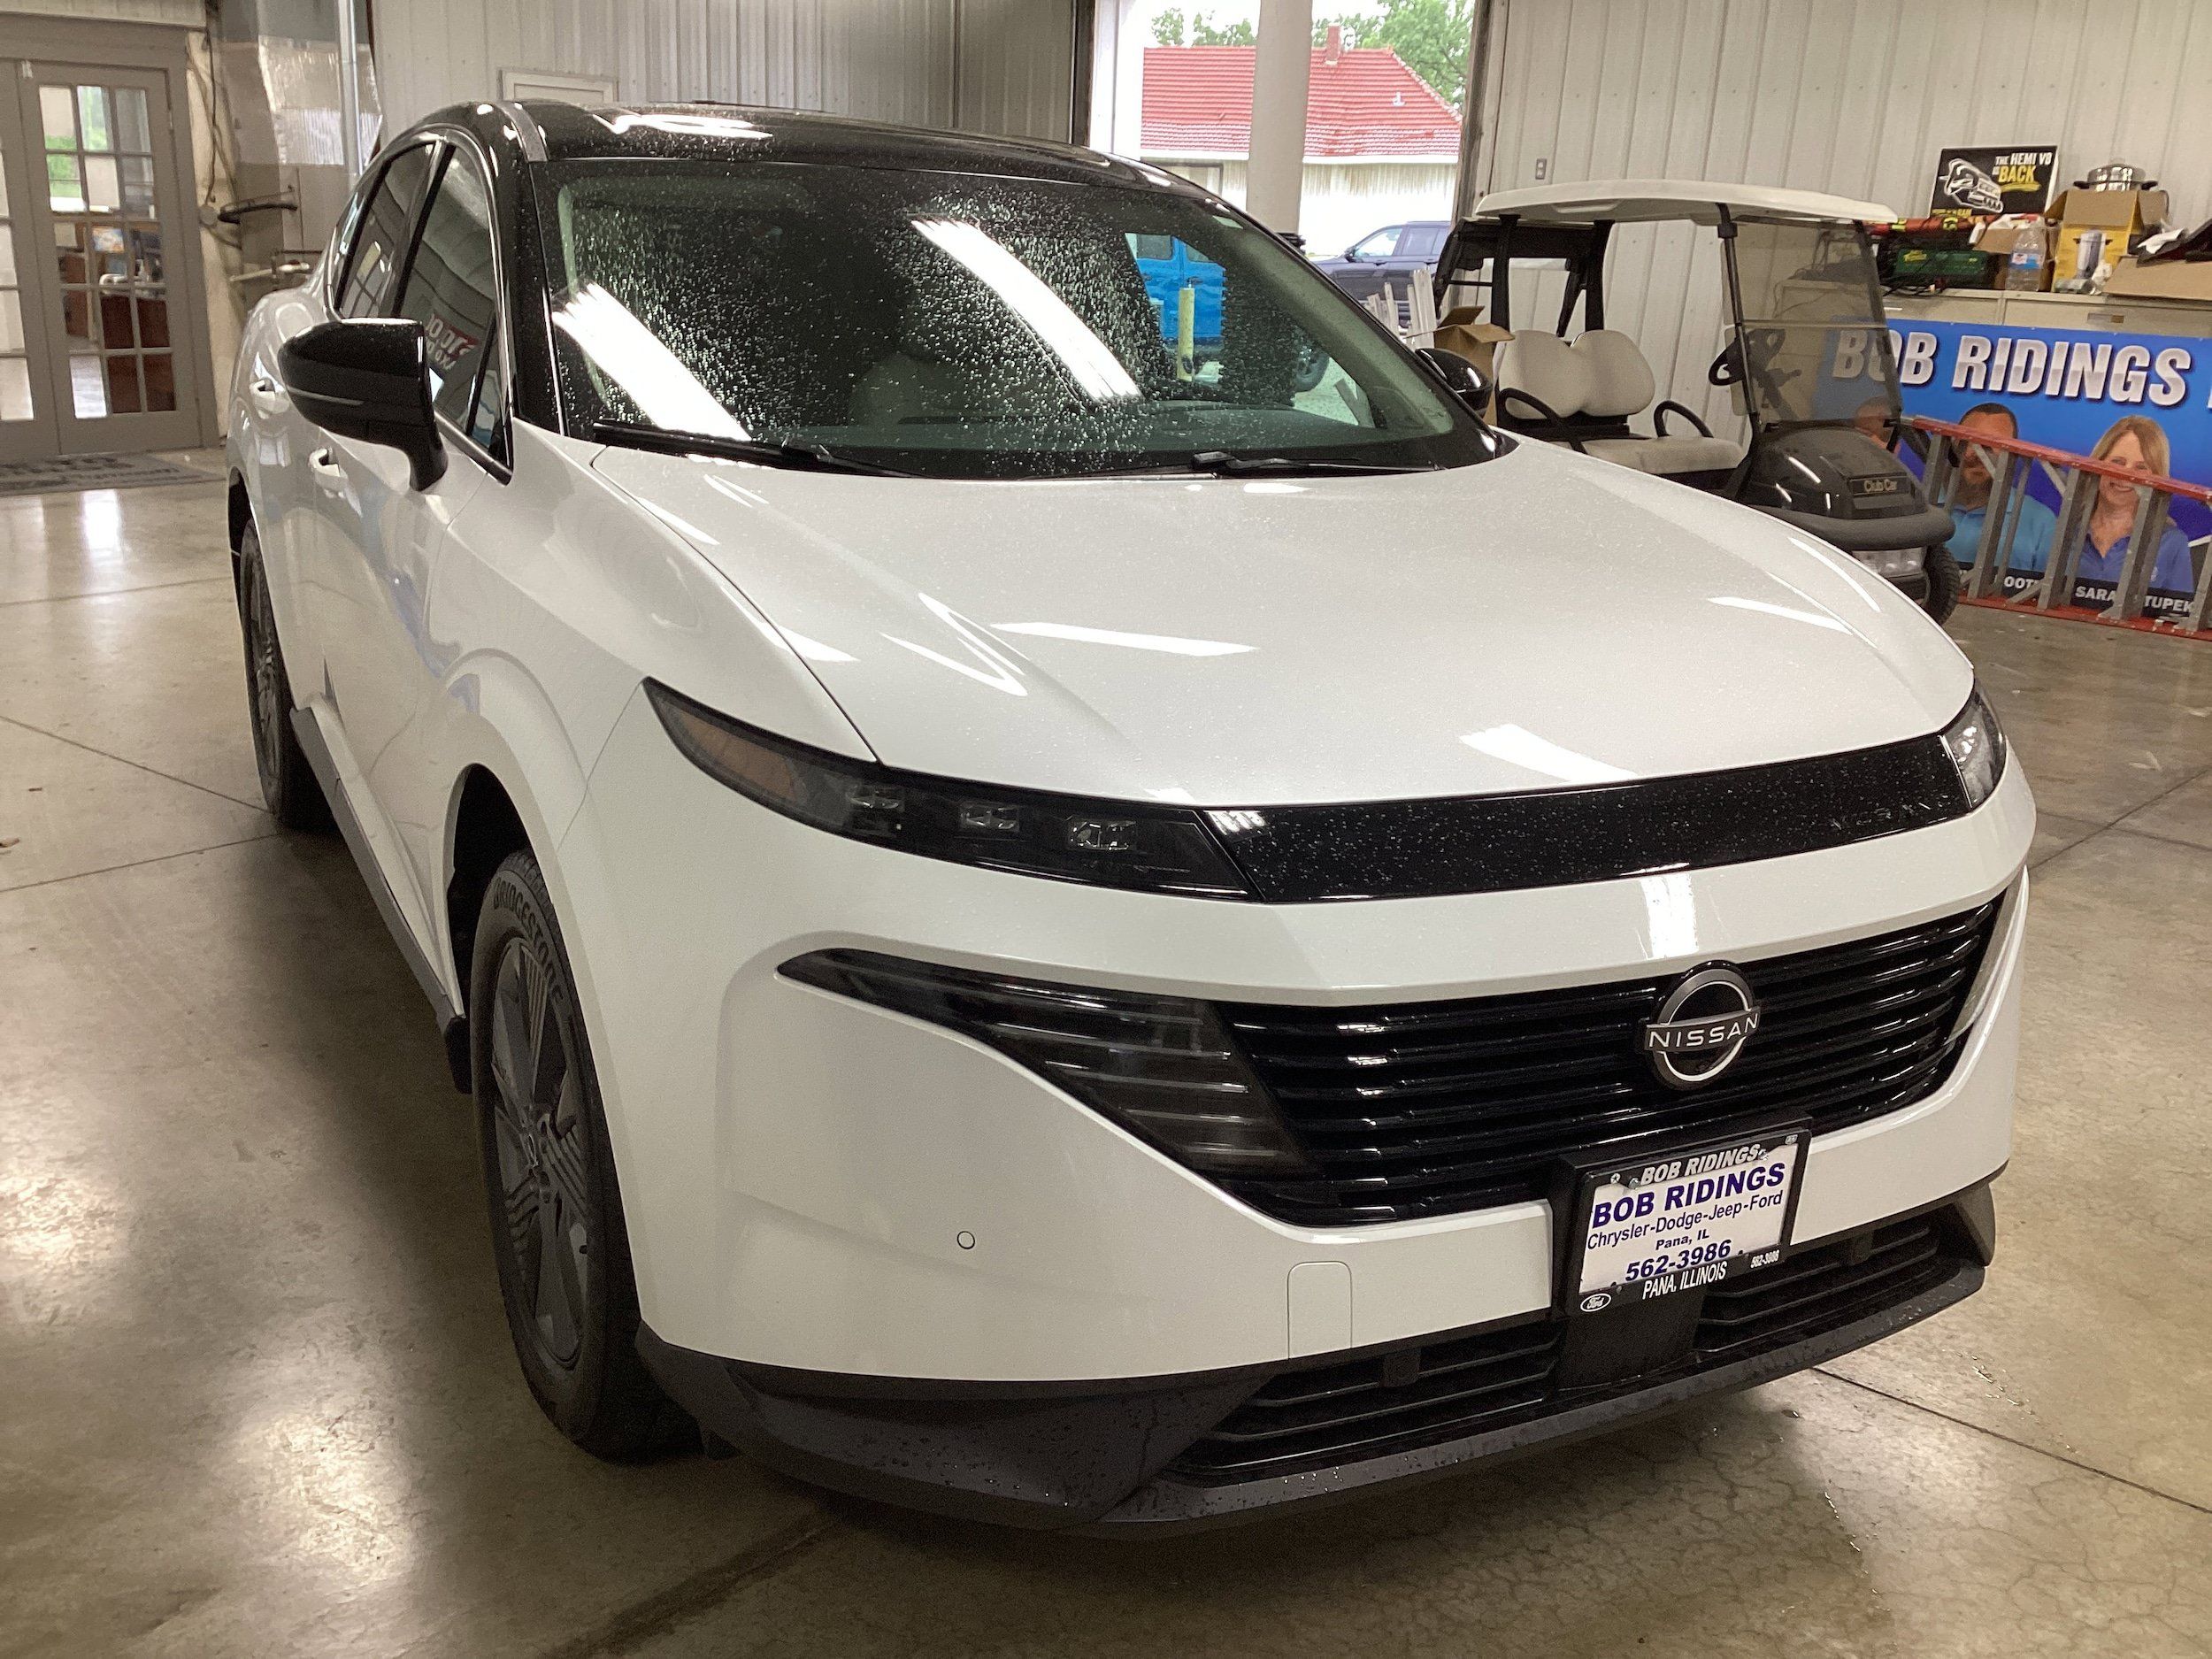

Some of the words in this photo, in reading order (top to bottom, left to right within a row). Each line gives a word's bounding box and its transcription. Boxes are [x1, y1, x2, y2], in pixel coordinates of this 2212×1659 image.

[1995, 156, 2009, 165] THE
[2010, 152, 2038, 165] HEMI
[2039, 152, 2053, 165] V8
[1998, 165, 2036, 183] BACK
[1951, 334, 2192, 406] RIDINGS
[1863, 480, 1884, 493] Club
[1884, 479, 1898, 491] Car
[2145, 595, 2195, 612] TUPEK
[1649, 1012, 1758, 1048] NISSAN
[1640, 1162, 1680, 1186] BOB
[1685, 1143, 1761, 1176] RIDINGS
[1592, 1192, 1655, 1228] BOB
[1664, 1163, 1786, 1211] RIDINGS
[1587, 1190, 1783, 1251] Chrysler-Dodge-Jeep-Ford
[1655, 1235, 1693, 1250] Pana,
[1697, 1230, 1709, 1241] IL
[1625, 1240, 1732, 1282] 562-3986
[1679, 1261, 1727, 1290] ILLINOIS
